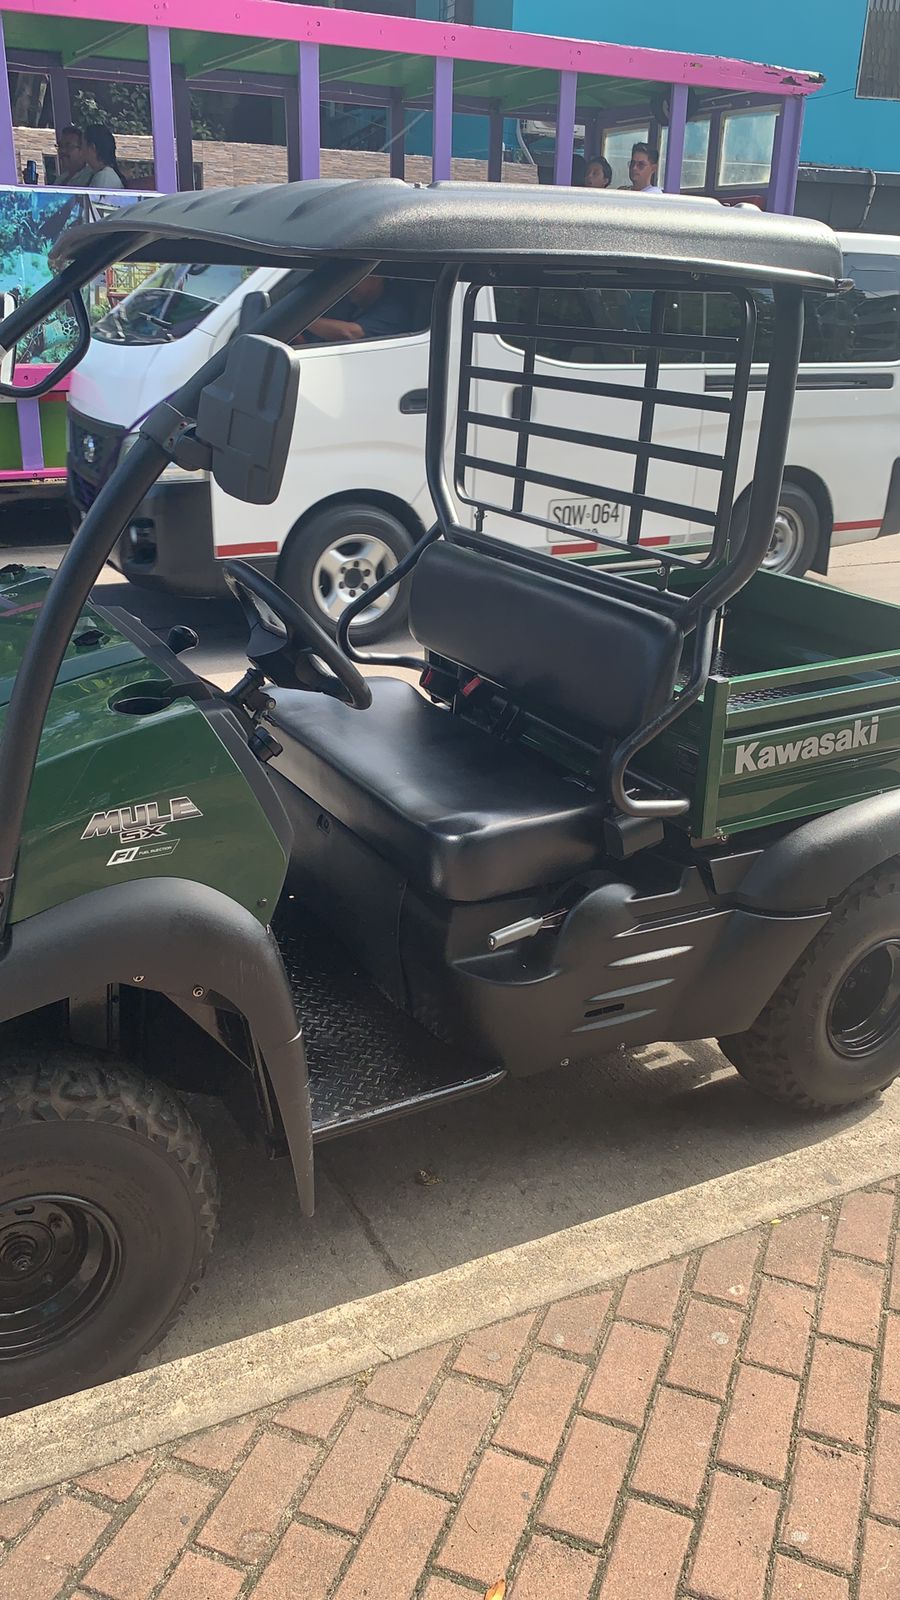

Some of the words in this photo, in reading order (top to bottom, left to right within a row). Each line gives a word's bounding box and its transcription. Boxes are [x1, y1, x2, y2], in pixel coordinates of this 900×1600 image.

[734, 716, 879, 774] Kawasaki
[80, 796, 203, 840] MULE
[120, 824, 167, 844] SX
